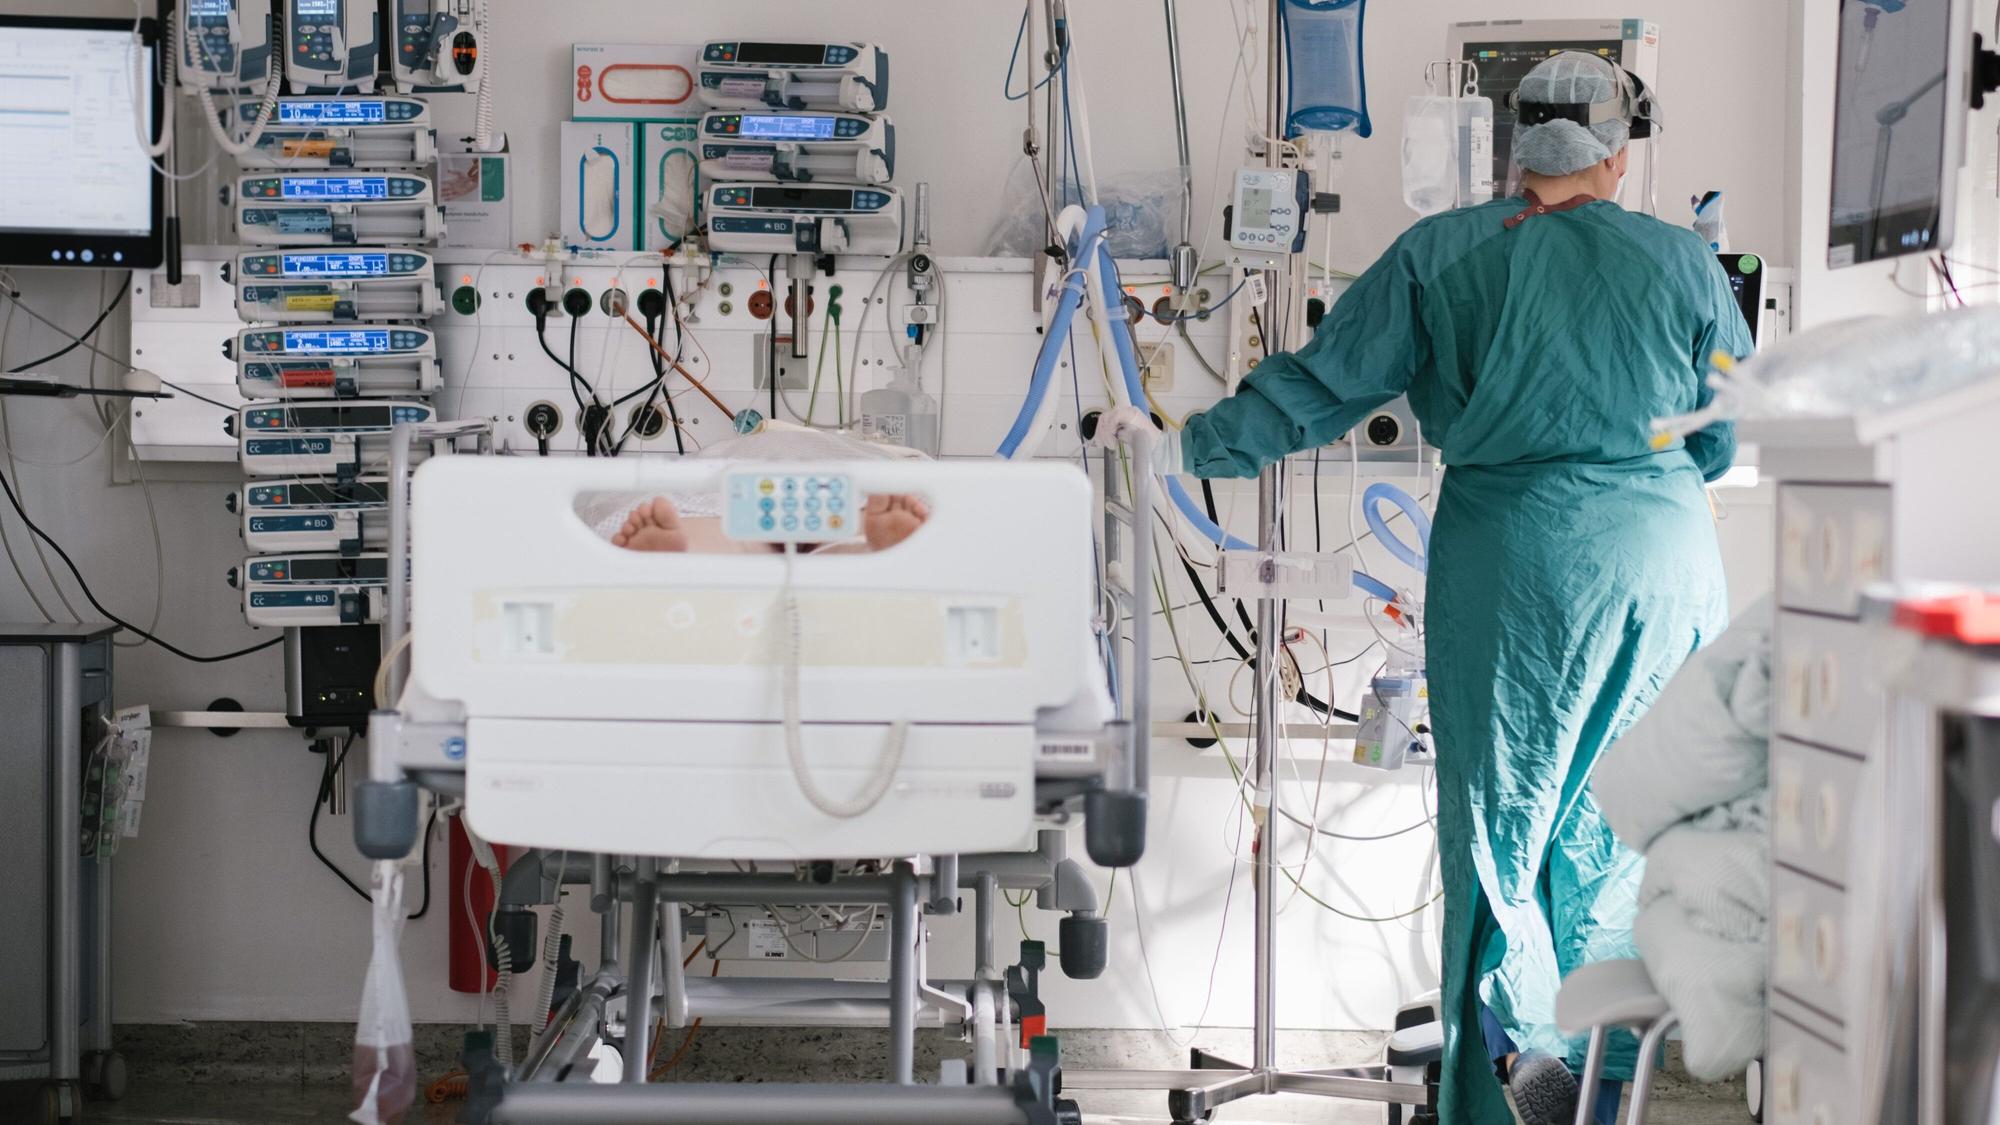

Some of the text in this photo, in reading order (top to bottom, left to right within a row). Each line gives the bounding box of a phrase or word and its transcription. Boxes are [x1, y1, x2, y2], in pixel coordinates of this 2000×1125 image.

[245, 214, 258, 223] CC
[714, 222, 726, 231] CC
[773, 222, 787, 231] BD
[247, 368, 260, 377] CC
[249, 445, 261, 453] CC
[311, 442, 324, 451] BD
[252, 522, 264, 531] CC
[314, 519, 328, 528] BD
[253, 597, 265, 606] CC
[315, 594, 329, 603] BD
